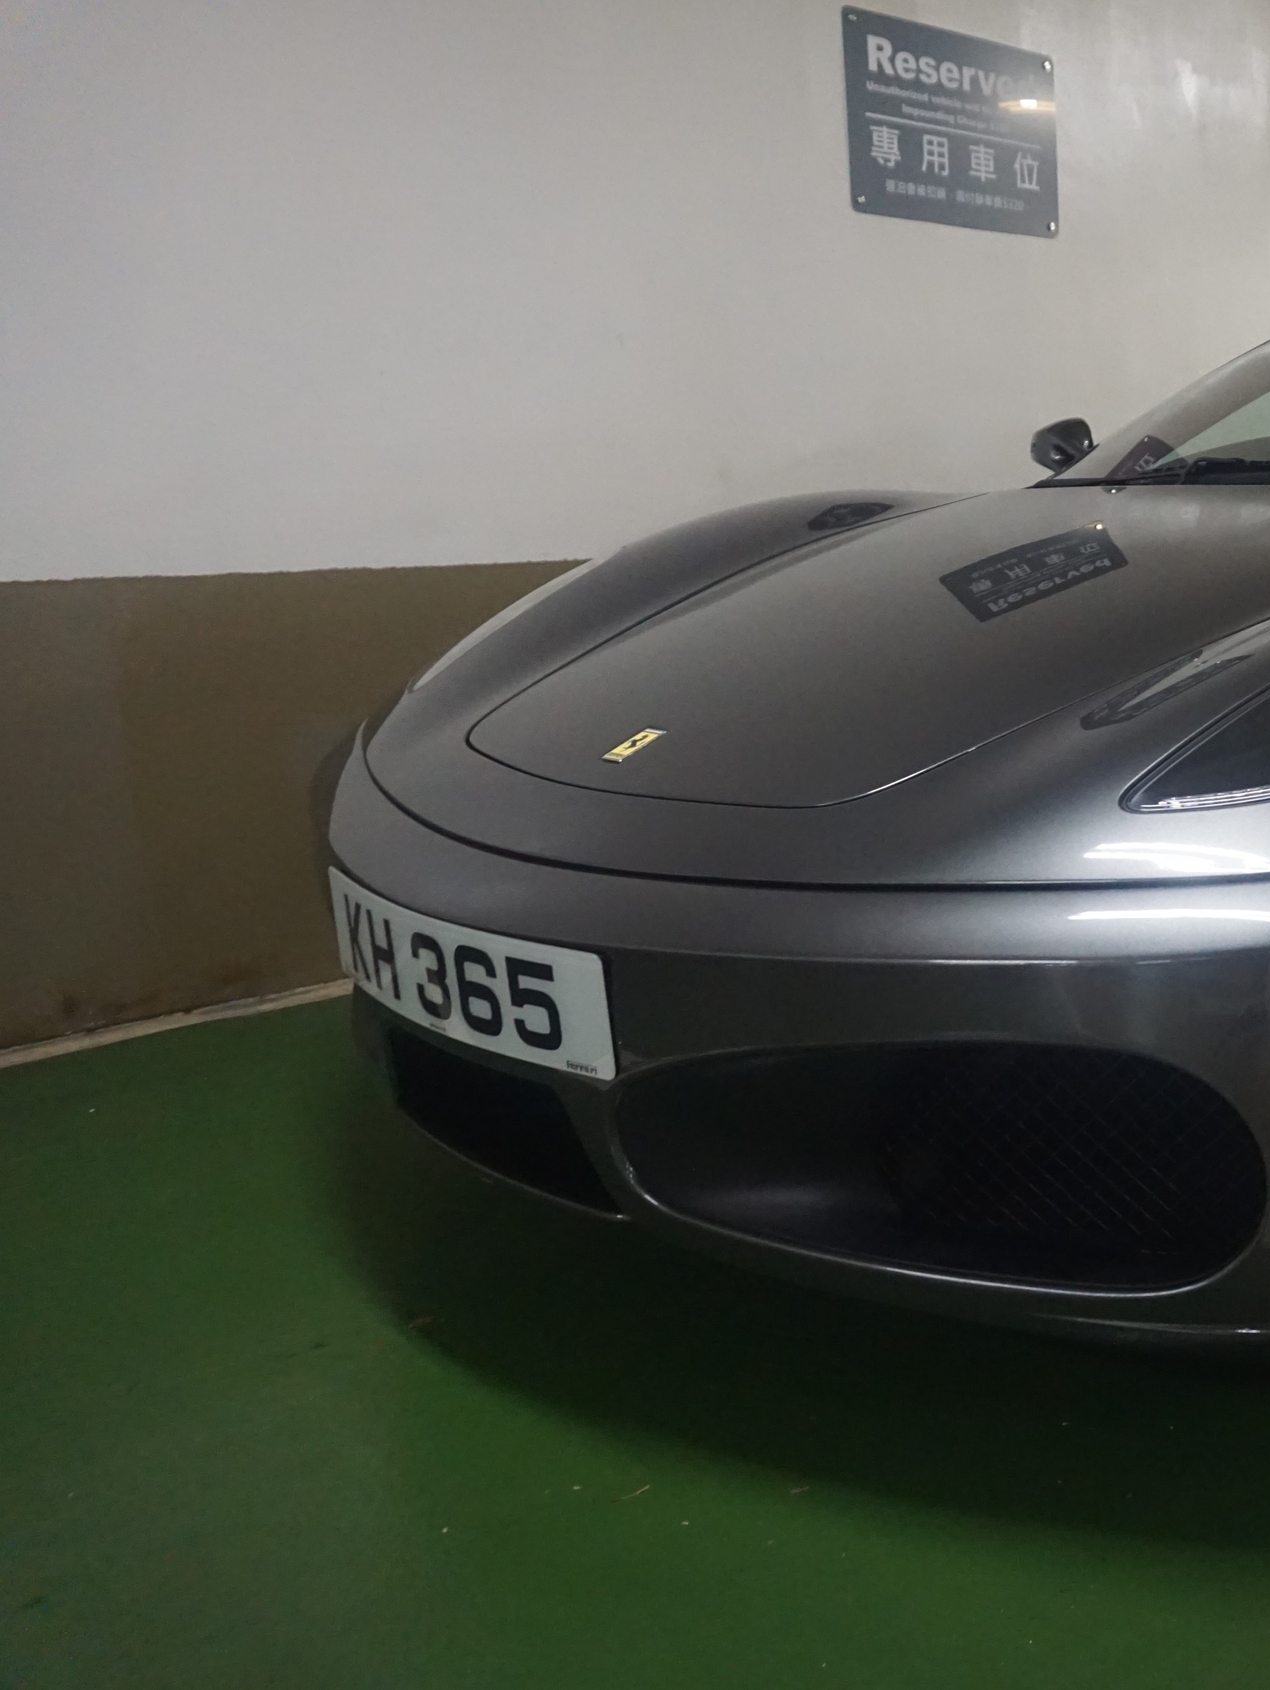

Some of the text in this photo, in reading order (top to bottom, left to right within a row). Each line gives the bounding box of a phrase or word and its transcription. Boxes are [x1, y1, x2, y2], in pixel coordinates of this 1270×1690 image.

[869, 124, 1040, 192] 專用車位
[343, 893, 564, 1052] KH 365
